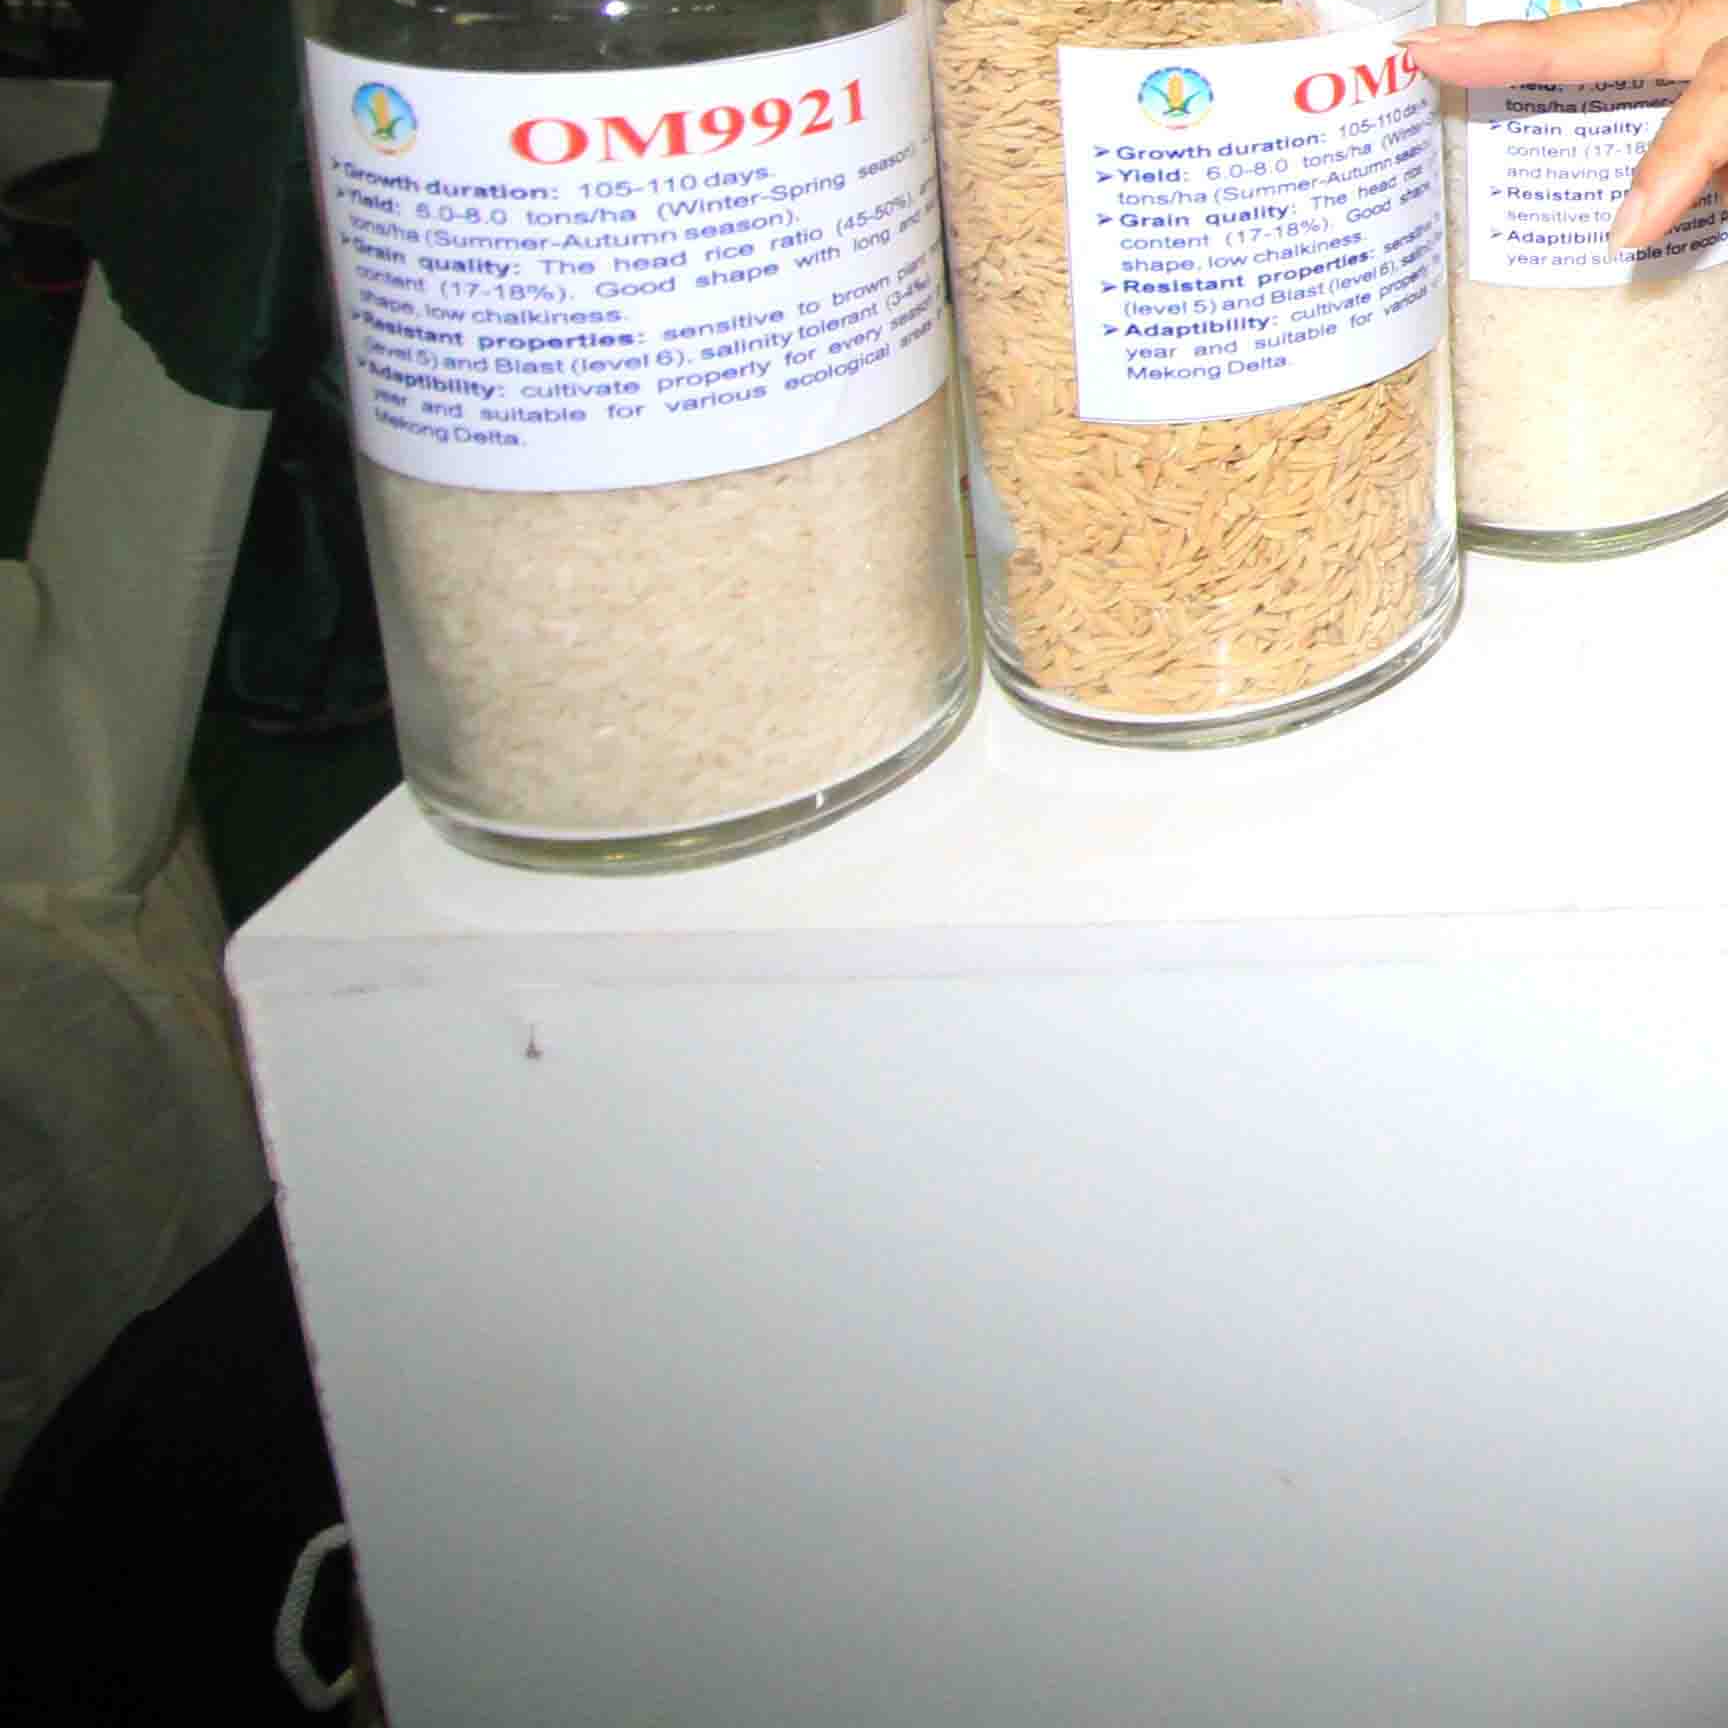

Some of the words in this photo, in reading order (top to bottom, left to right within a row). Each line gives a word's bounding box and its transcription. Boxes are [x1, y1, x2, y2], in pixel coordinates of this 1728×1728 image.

[509, 78, 865, 165] OM9921
[1506, 98, 1577, 113] tons/ha
[1116, 144, 1212, 160] Growth
[1217, 133, 1327, 157] duration:
[1339, 108, 1400, 137] 105-110
[1506, 121, 1562, 136] Grain
[1574, 120, 1649, 138] quality:
[1118, 168, 1191, 183] Yield:
[1303, 143, 1372, 169] tons/ha
[1506, 144, 1577, 159] content
[426, 179, 560, 202] duration:
[579, 174, 698, 200] 105-110
[1118, 190, 1208, 206] tons/ha
[1213, 157, 1393, 205] (Summer-Autumn
[1506, 166, 1542, 179] and
[1545, 166, 1610, 181] having
[1506, 186, 1603, 202] Resistant
[526, 206, 636, 226] tons/ha
[657, 172, 846, 221] (Winter-Spring
[1119, 213, 1190, 227] Grain
[1205, 203, 1297, 227] quality:
[1310, 193, 1347, 210] The
[1506, 210, 1591, 223] sensitive
[1594, 210, 1612, 222] to
[424, 228, 677, 250] (Summer-Autumn
[684, 211, 800, 241] season).
[1119, 234, 1209, 250] content
[1346, 199, 1391, 223] Good
[417, 255, 521, 278] quality:
[540, 258, 595, 274] The
[613, 250, 687, 273] head
[704, 243, 754, 262] rice
[770, 227, 823, 251] ratio
[595, 276, 676, 298] Good
[695, 262, 779, 289] shape
[793, 244, 841, 269] with
[853, 227, 890, 253] long
[1122, 275, 1244, 294] Resistant
[1257, 249, 1376, 288] properties:
[1207, 255, 1248, 269] low
[1506, 252, 1547, 267] year
[1551, 251, 1587, 266] and
[1591, 246, 1663, 265] suitable
[1665, 241, 1688, 256] for
[1123, 299, 1188, 318] (level
[1193, 299, 1217, 315] 5)
[1221, 293, 1265, 311] and
[1271, 282, 1325, 304] Blast
[1329, 266, 1377, 295] (level
[470, 307, 630, 325] chalkiness.
[477, 333, 646, 352] properties:
[663, 311, 785, 341] sensitive
[797, 300, 820, 316] to
[832, 276, 890, 307] brown
[1124, 314, 1279, 339] Adaptibility:
[1290, 292, 1372, 322] cultivate
[443, 356, 488, 373] and
[494, 357, 565, 374] Blast
[570, 353, 649, 376] (level
[700, 330, 793, 361] salinity
[798, 302, 879, 340] tolerant
[1125, 346, 1177, 362] year
[1193, 340, 1238, 357] and
[1254, 323, 1337, 350] suitable
[1350, 311, 1374, 328] for
[422, 401, 463, 418] and
[479, 407, 587, 423] suitable
[607, 403, 646, 419] for
[663, 384, 767, 413] various
[784, 343, 890, 390] ecological
[520, 380, 640, 399] cultivate
[657, 359, 771, 395] properly
[784, 346, 817, 367] for
[829, 325, 883, 354] every
[1127, 366, 1222, 380] Mekong
[453, 426, 527, 446] Delta.
